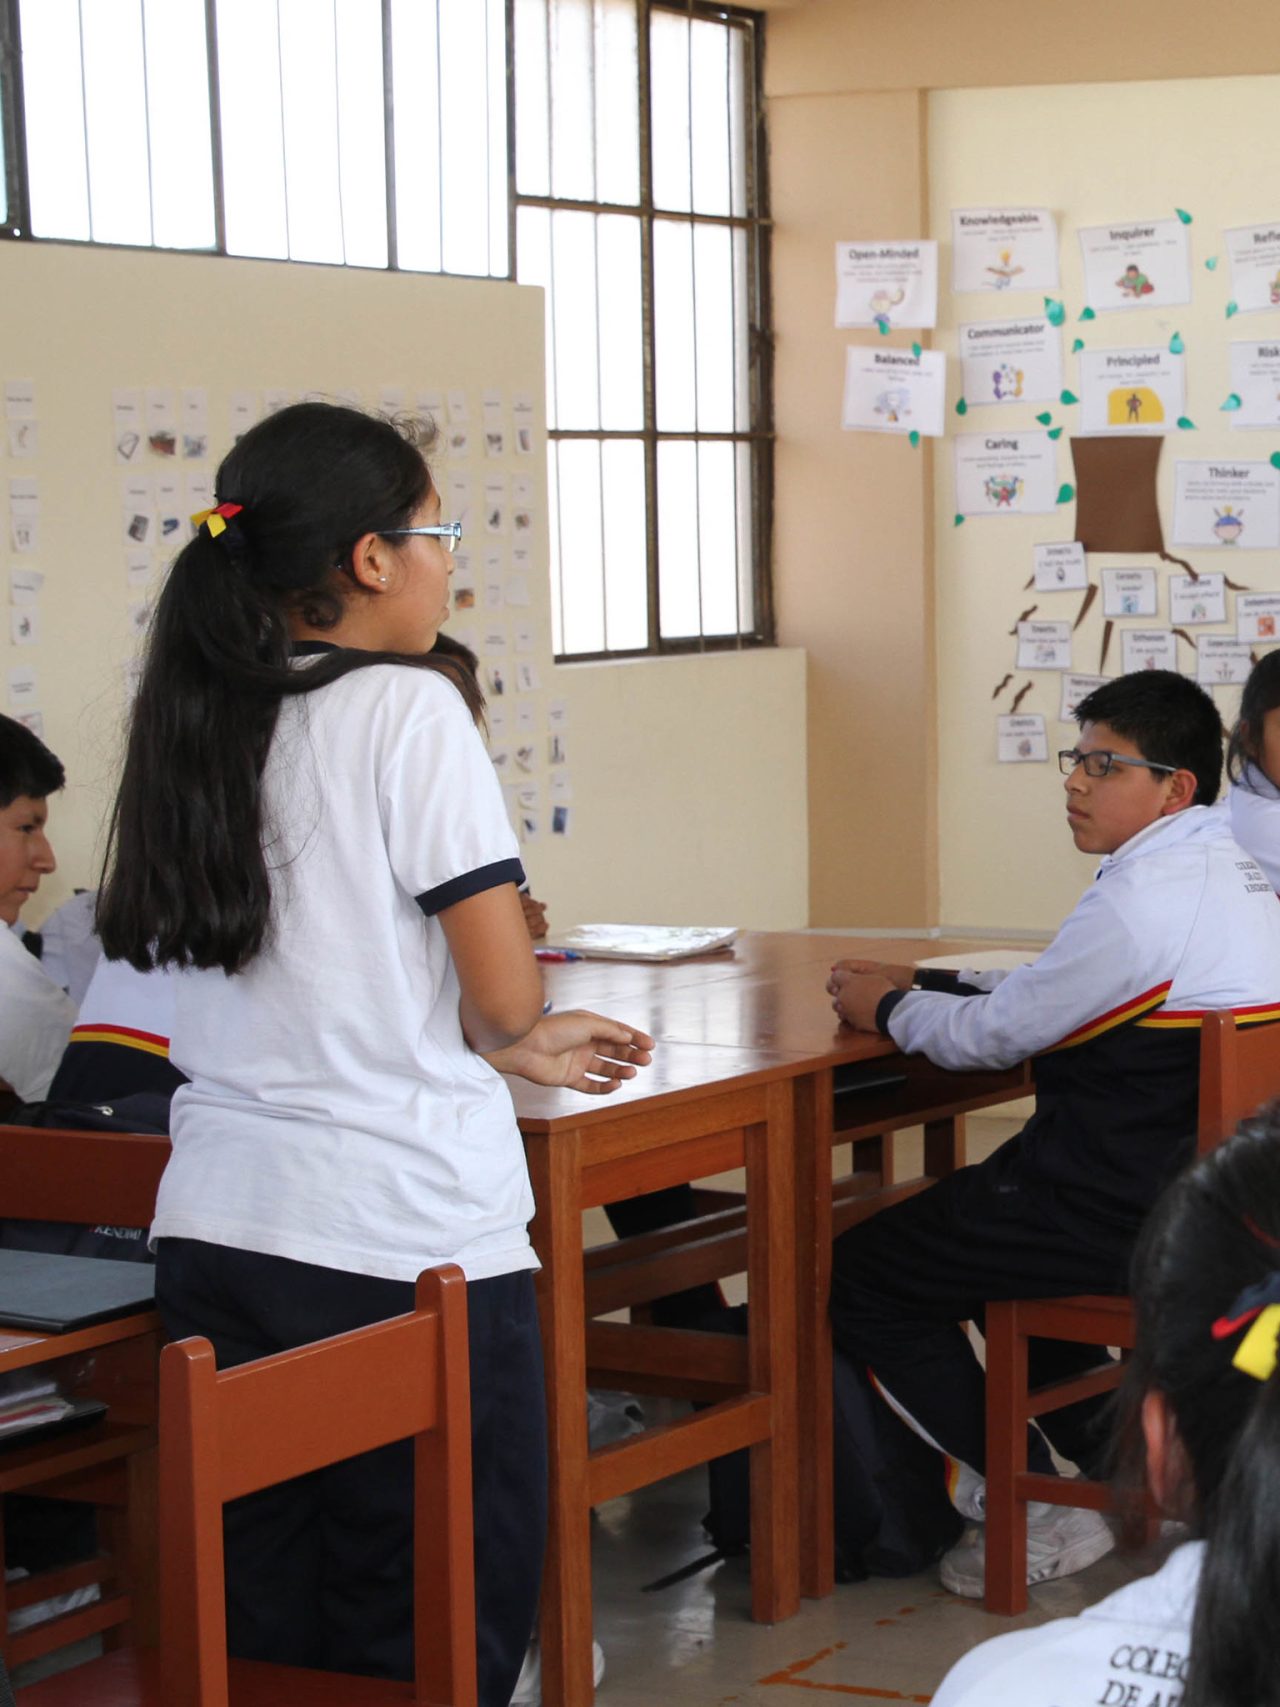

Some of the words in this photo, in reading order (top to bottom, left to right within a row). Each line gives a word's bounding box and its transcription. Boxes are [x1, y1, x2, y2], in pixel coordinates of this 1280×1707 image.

[1109, 227, 1156, 243] Inquirer
[848, 249, 920, 262] Open-Minded
[967, 323, 1045, 340] Communicator
[874, 353, 921, 366] Balanced
[1257, 347, 1280, 358] Risk
[1106, 353, 1161, 369] Principled
[985, 438, 1019, 452] Caring
[1208, 466, 1250, 479] Thinker
[1110, 1644, 1189, 1680] COLE
